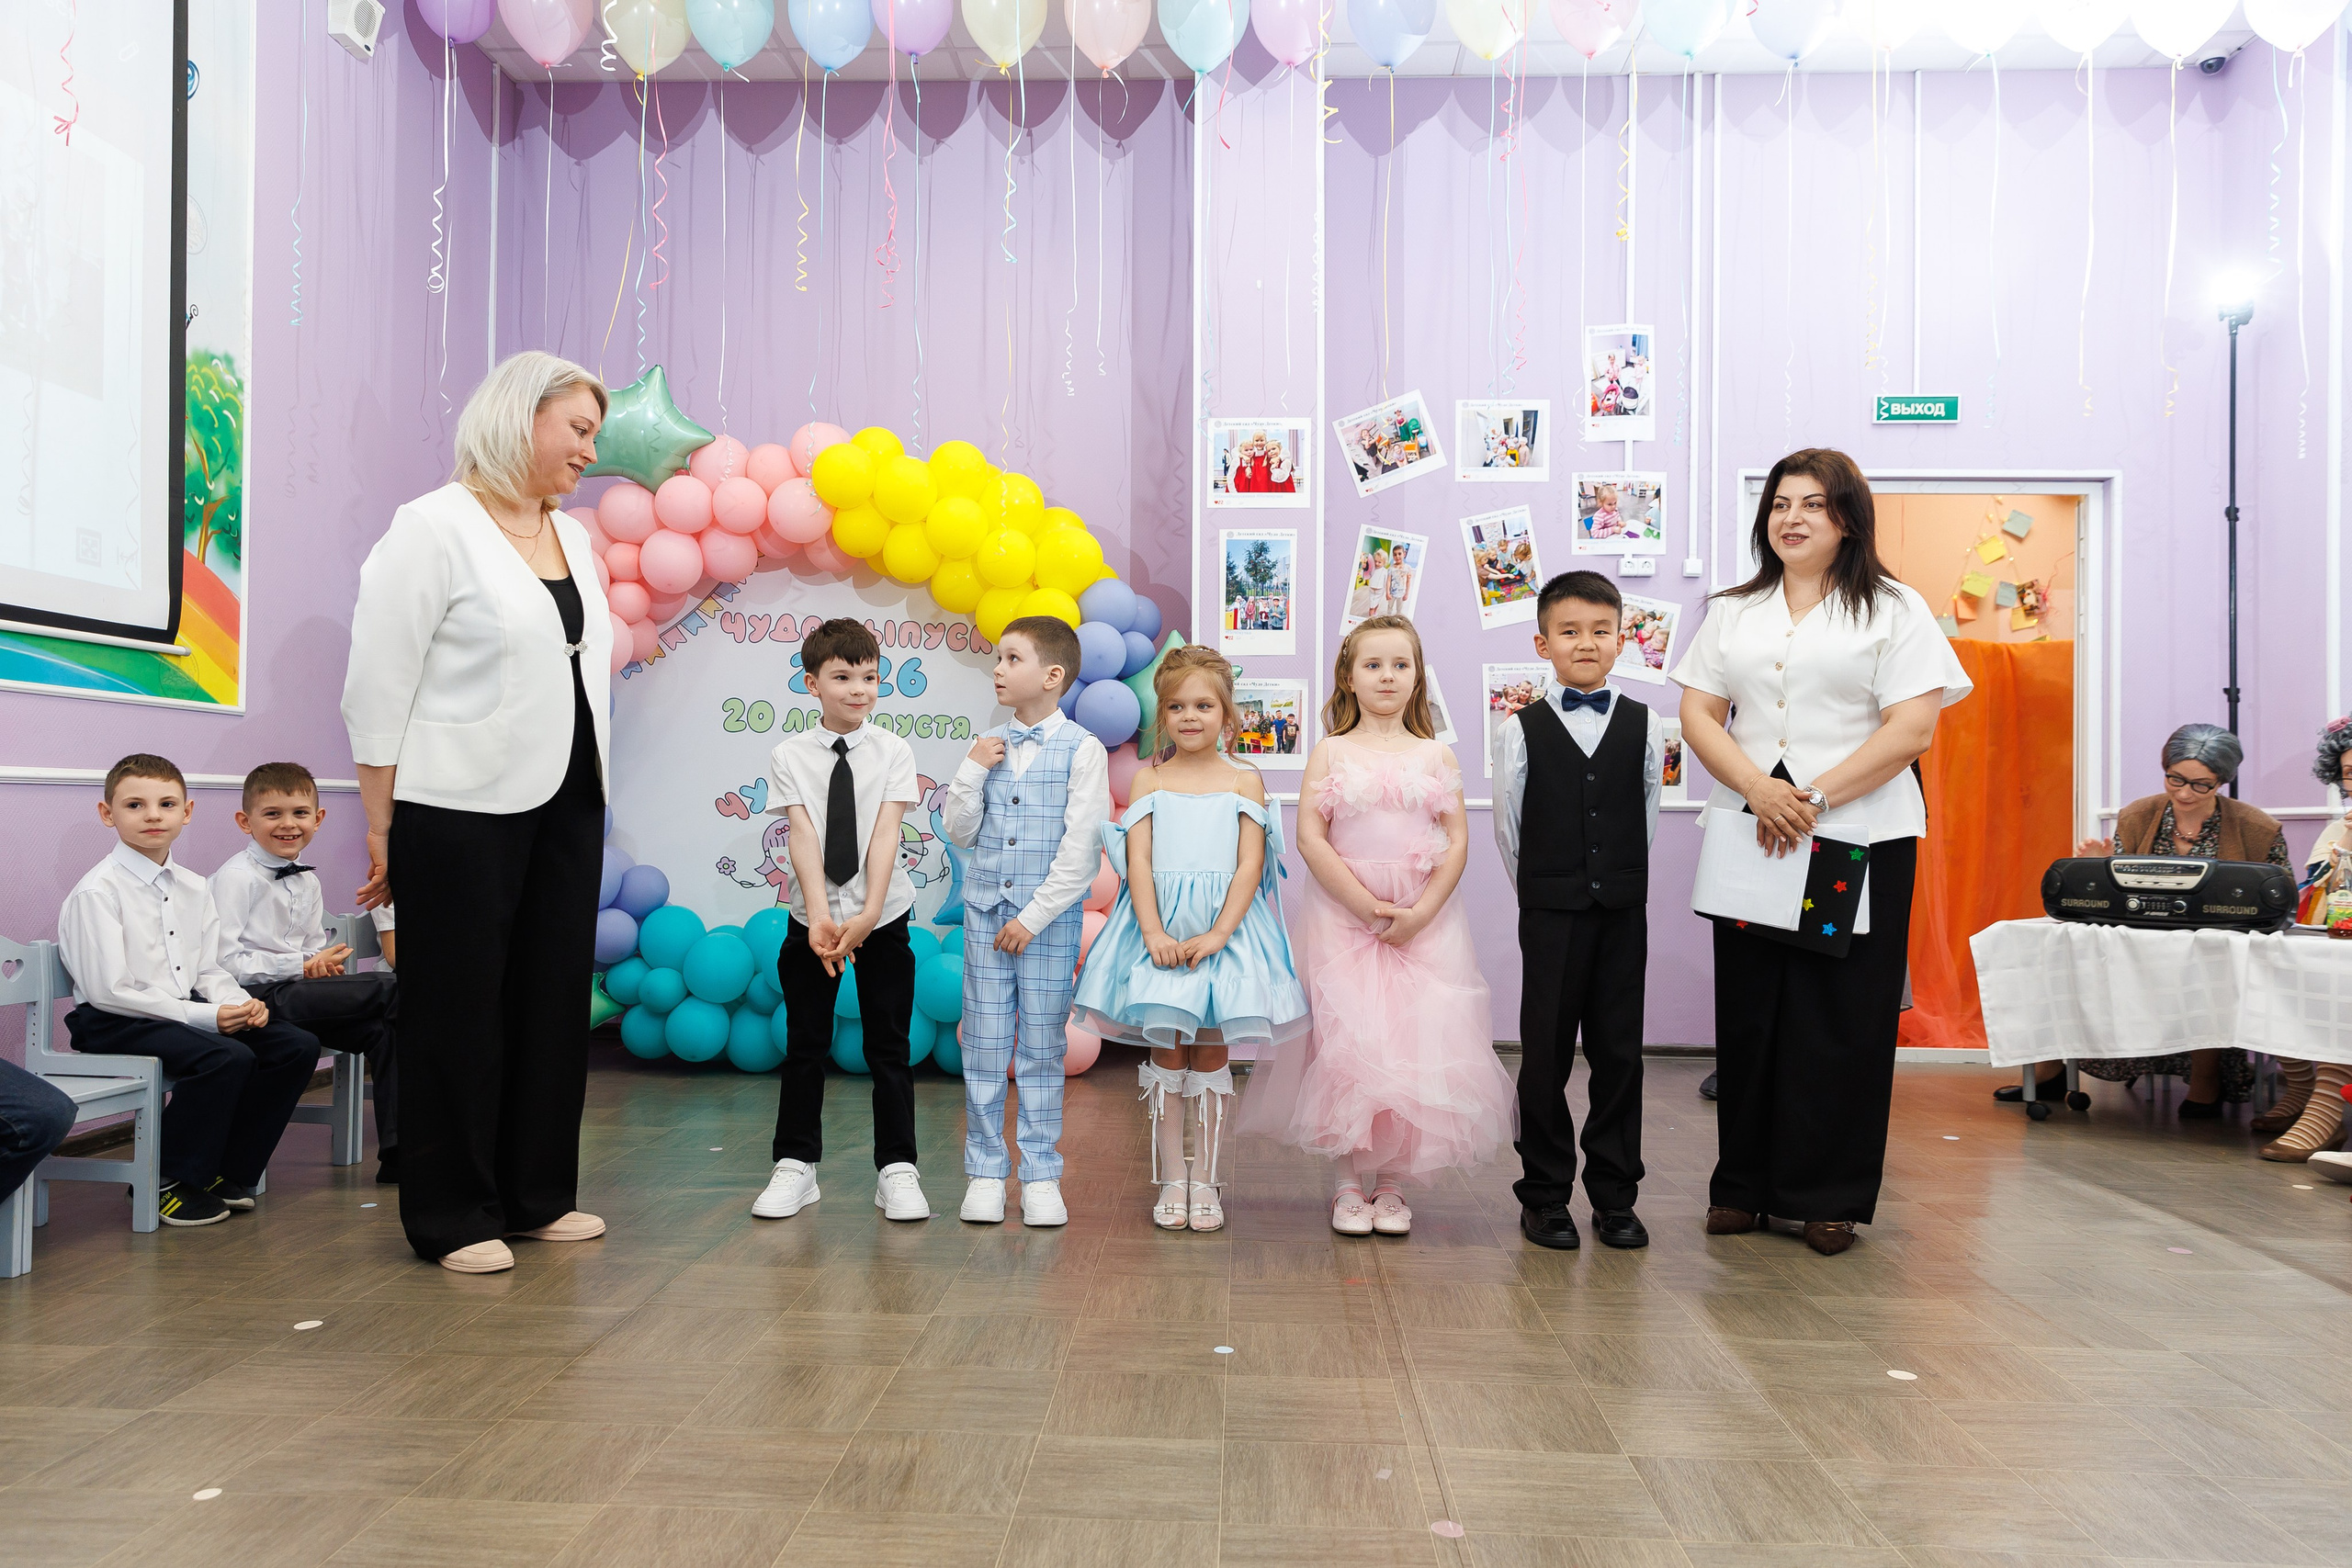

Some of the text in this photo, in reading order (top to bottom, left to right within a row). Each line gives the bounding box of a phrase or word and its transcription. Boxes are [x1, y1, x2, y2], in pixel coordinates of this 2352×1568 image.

[1890, 402, 1946, 417] ВЫХОД
[864, 618, 993, 655] ЫПУСК
[722, 697, 775, 733] 20
[782, 707, 821, 732] ЛЕ
[2060, 897, 2110, 908] SURROUND
[2202, 904, 2258, 915] SURROUND
